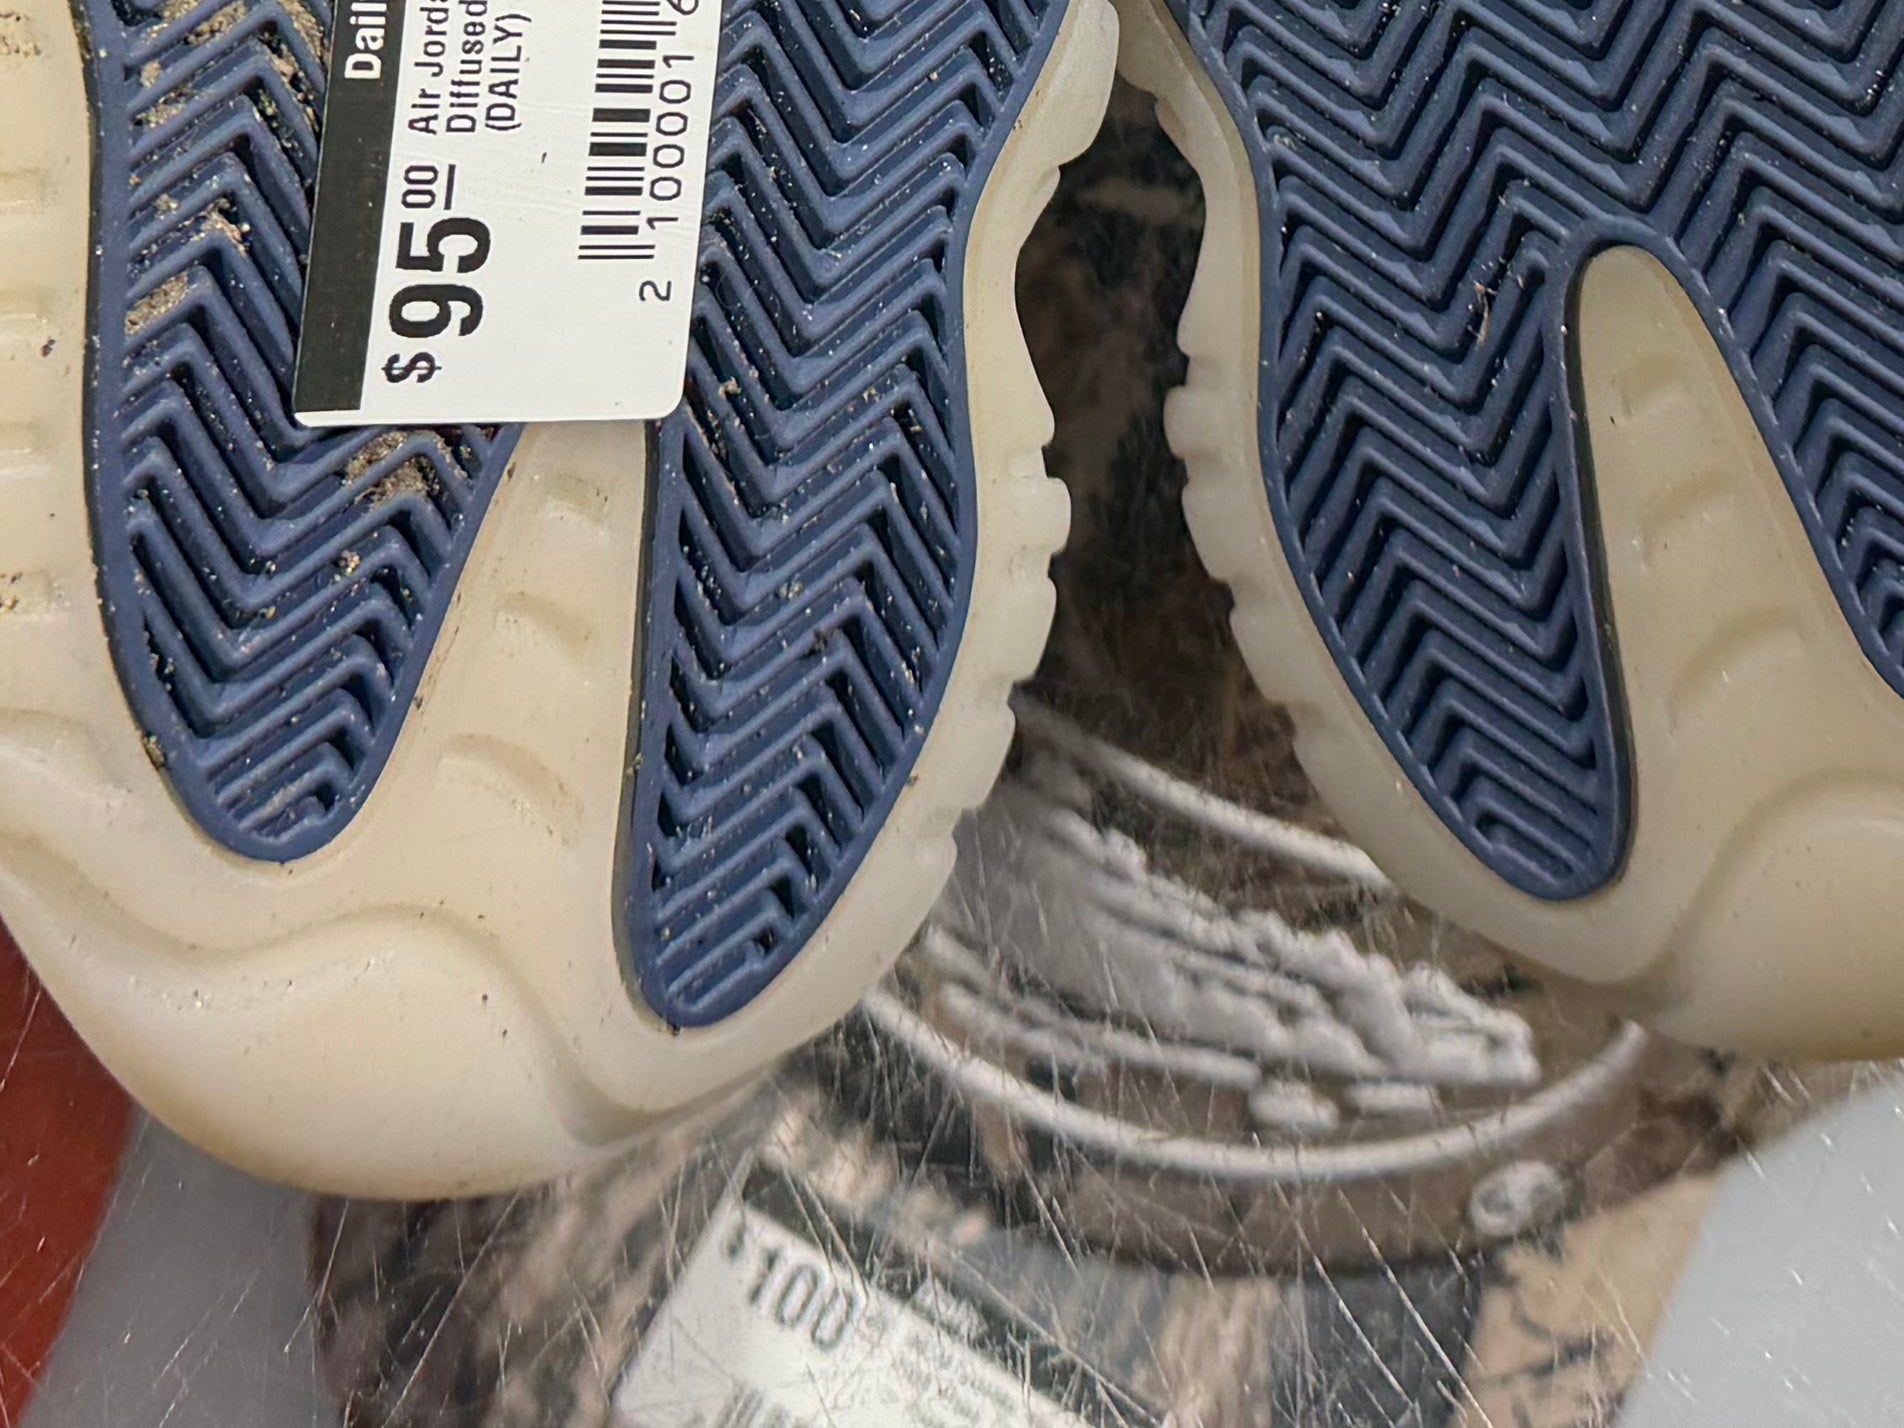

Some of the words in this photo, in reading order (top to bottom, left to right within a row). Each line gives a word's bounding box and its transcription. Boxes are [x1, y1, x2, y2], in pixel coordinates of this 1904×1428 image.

[408, 87, 441, 135] Air
[445, 0, 489, 133] Diffused
[484, 13, 532, 132] (DAILY)
[646, 55, 695, 230] 100001
[638, 280, 672, 302] 2
